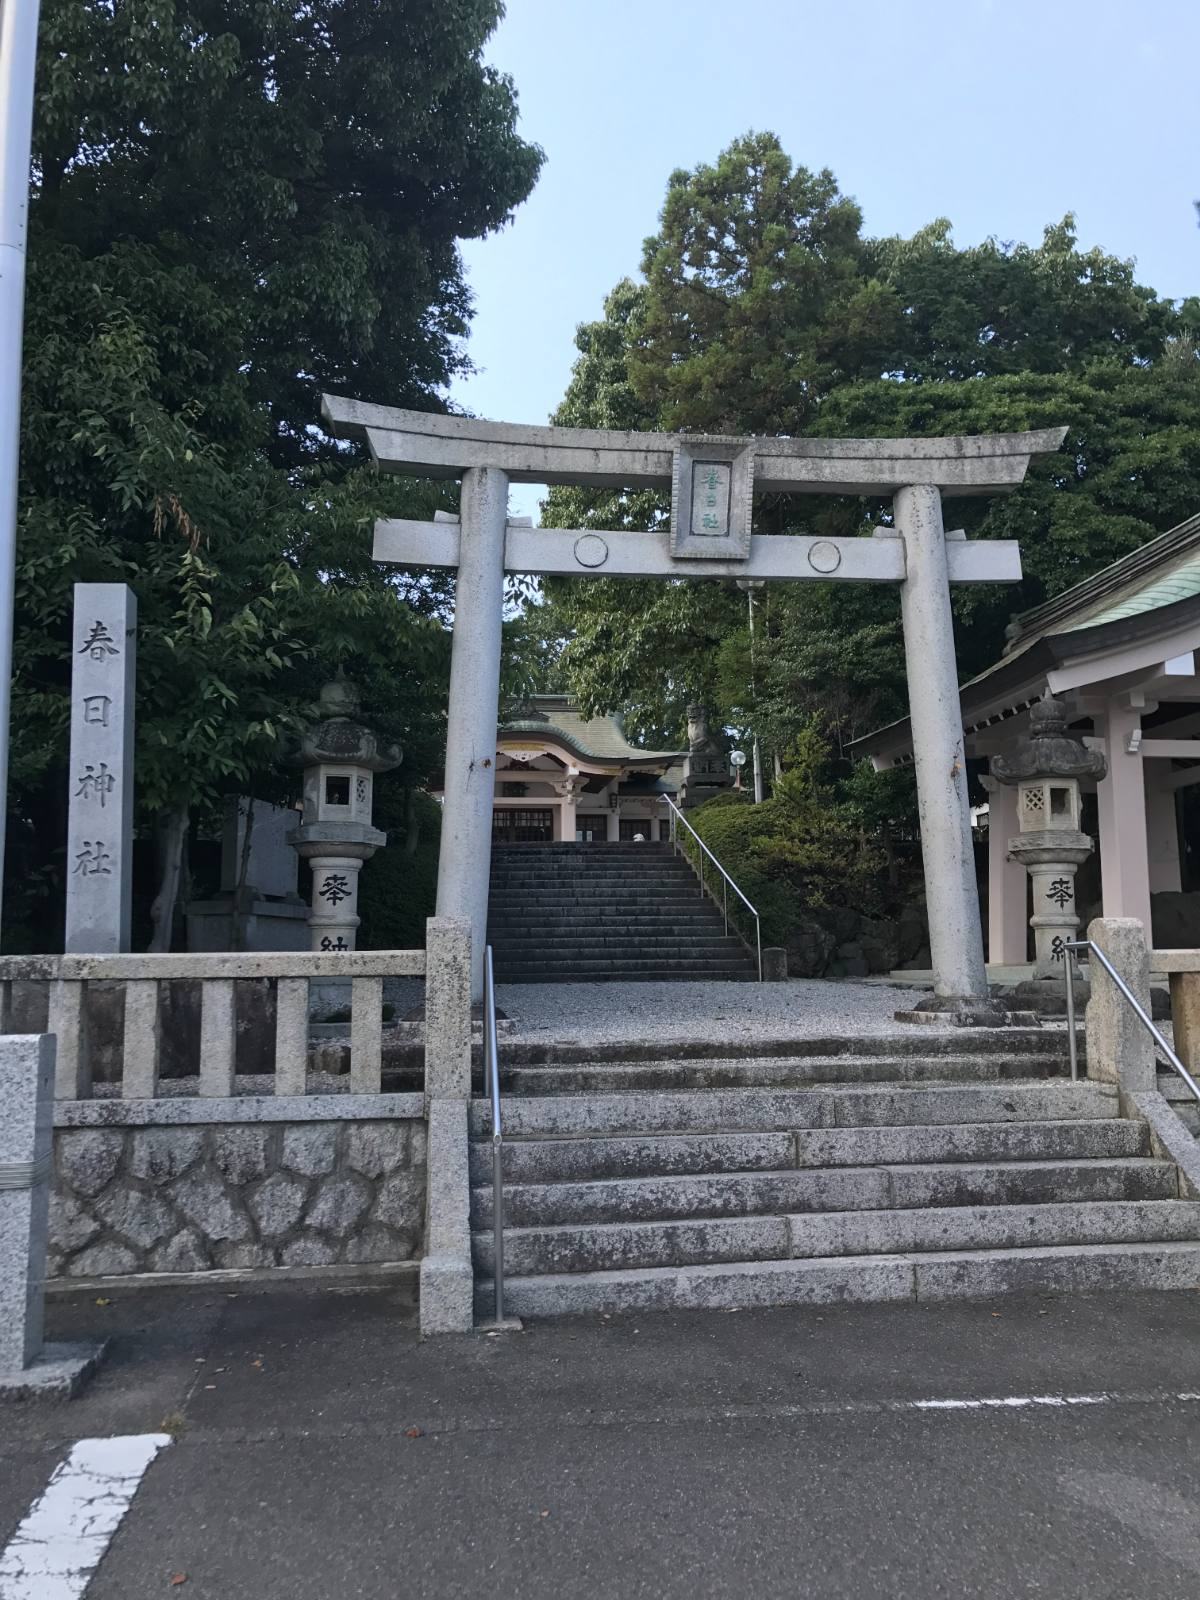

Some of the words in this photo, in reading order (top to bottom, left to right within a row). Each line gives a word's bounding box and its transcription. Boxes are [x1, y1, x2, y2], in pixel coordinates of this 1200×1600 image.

[700, 470, 723, 529] 春日社
[72, 620, 120, 876] 春日神社
